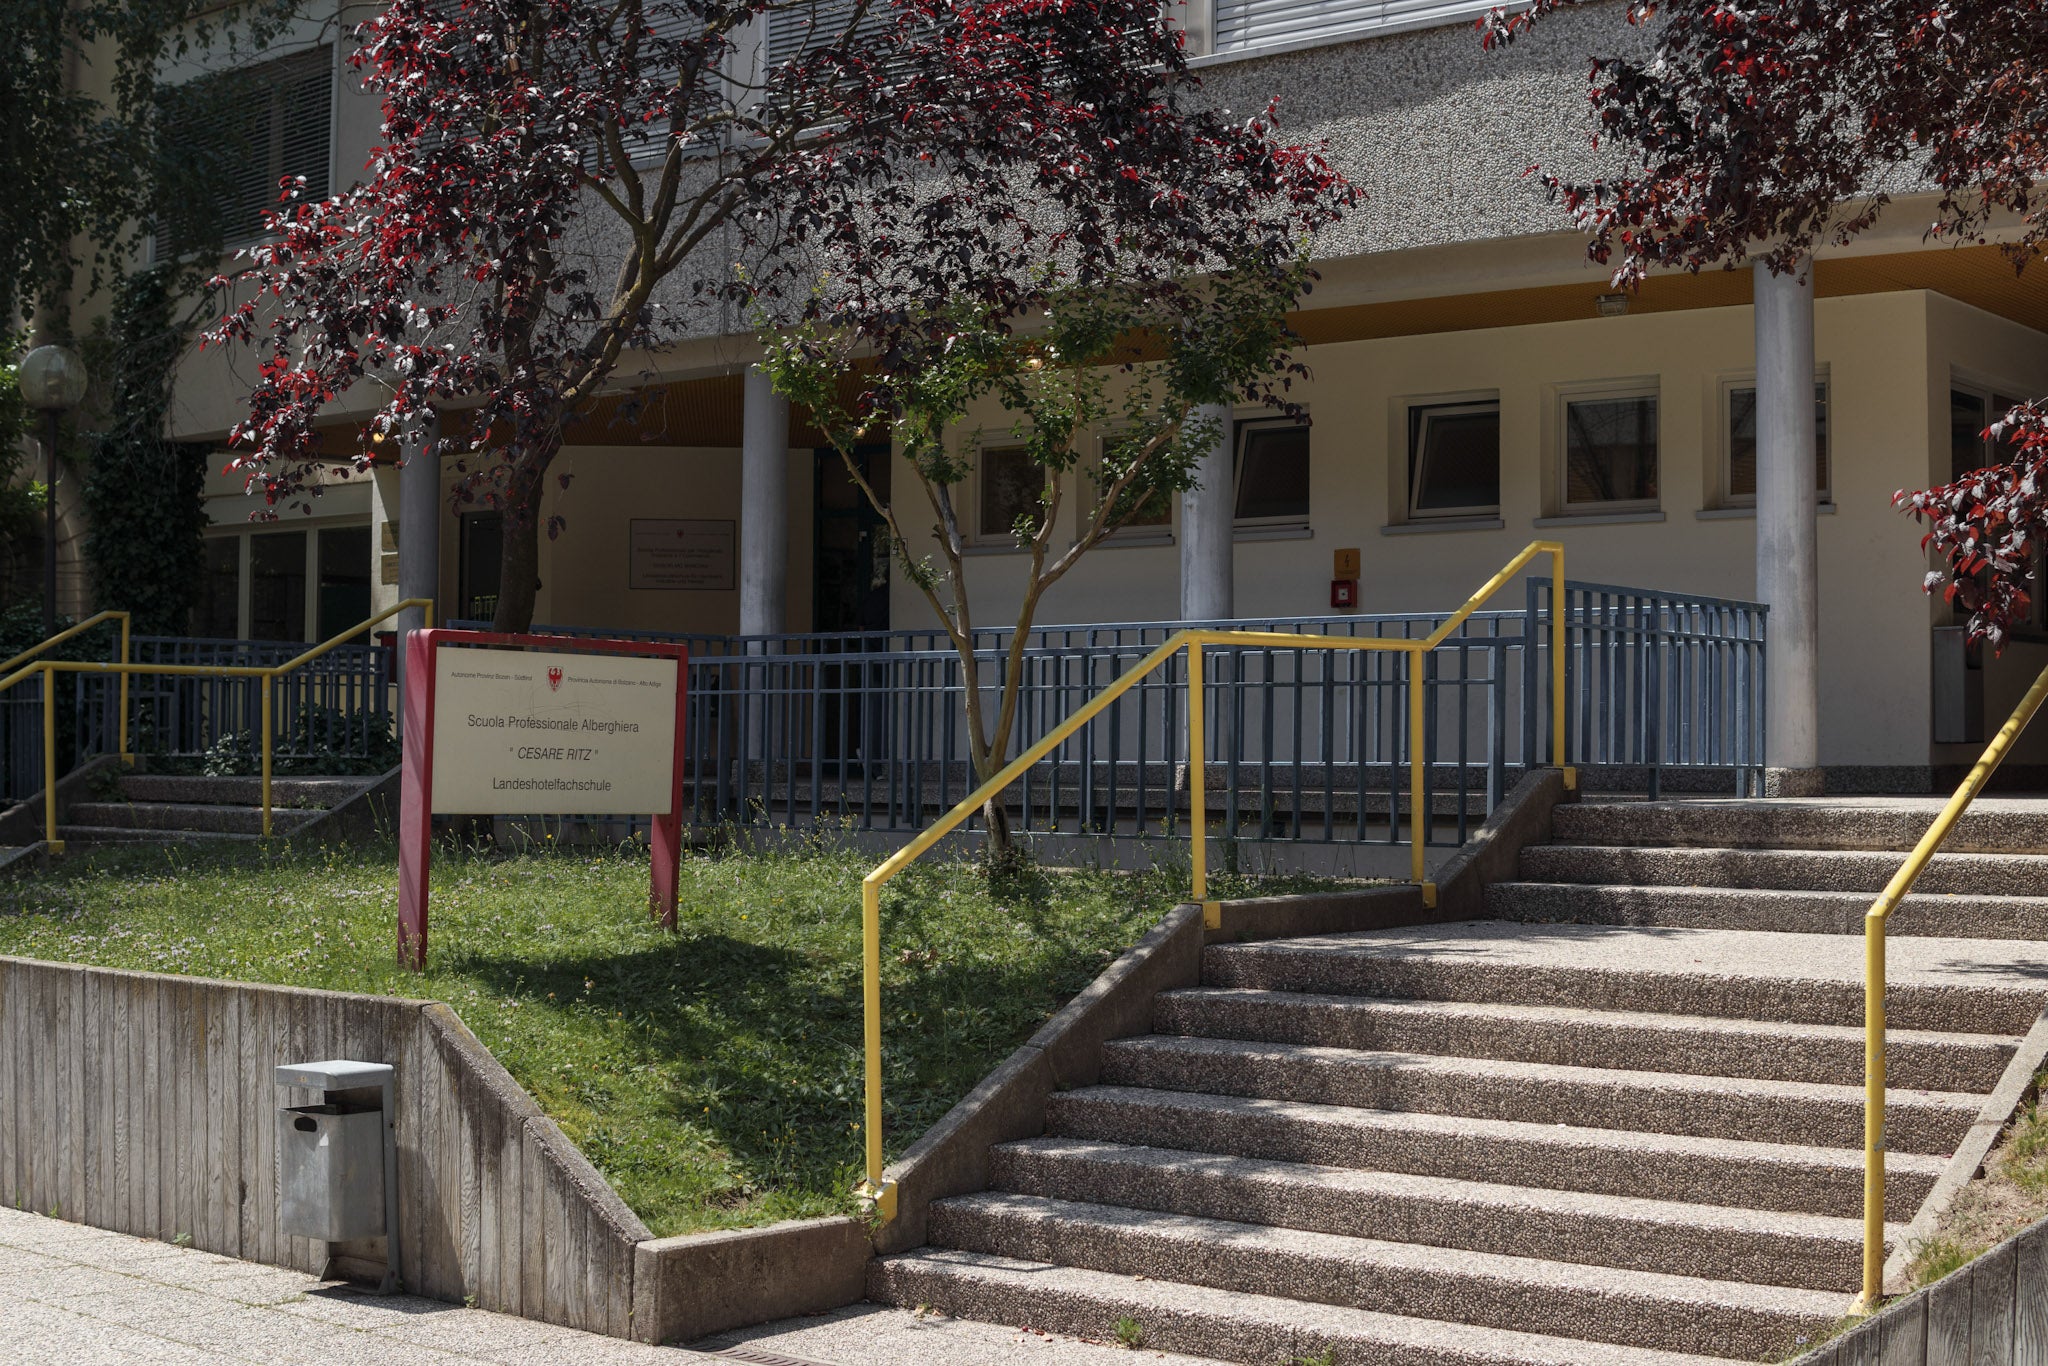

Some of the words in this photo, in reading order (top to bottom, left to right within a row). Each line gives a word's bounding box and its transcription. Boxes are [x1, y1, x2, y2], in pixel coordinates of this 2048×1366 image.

[451, 671, 476, 679] Autonome
[468, 714, 505, 729] Scuola
[508, 716, 578, 732] Professionale
[581, 718, 640, 735] Alberghiera
[517, 747, 564, 760] CESARE
[566, 748, 592, 761] RITZ
[492, 776, 612, 792] Landeshotelfachschule
